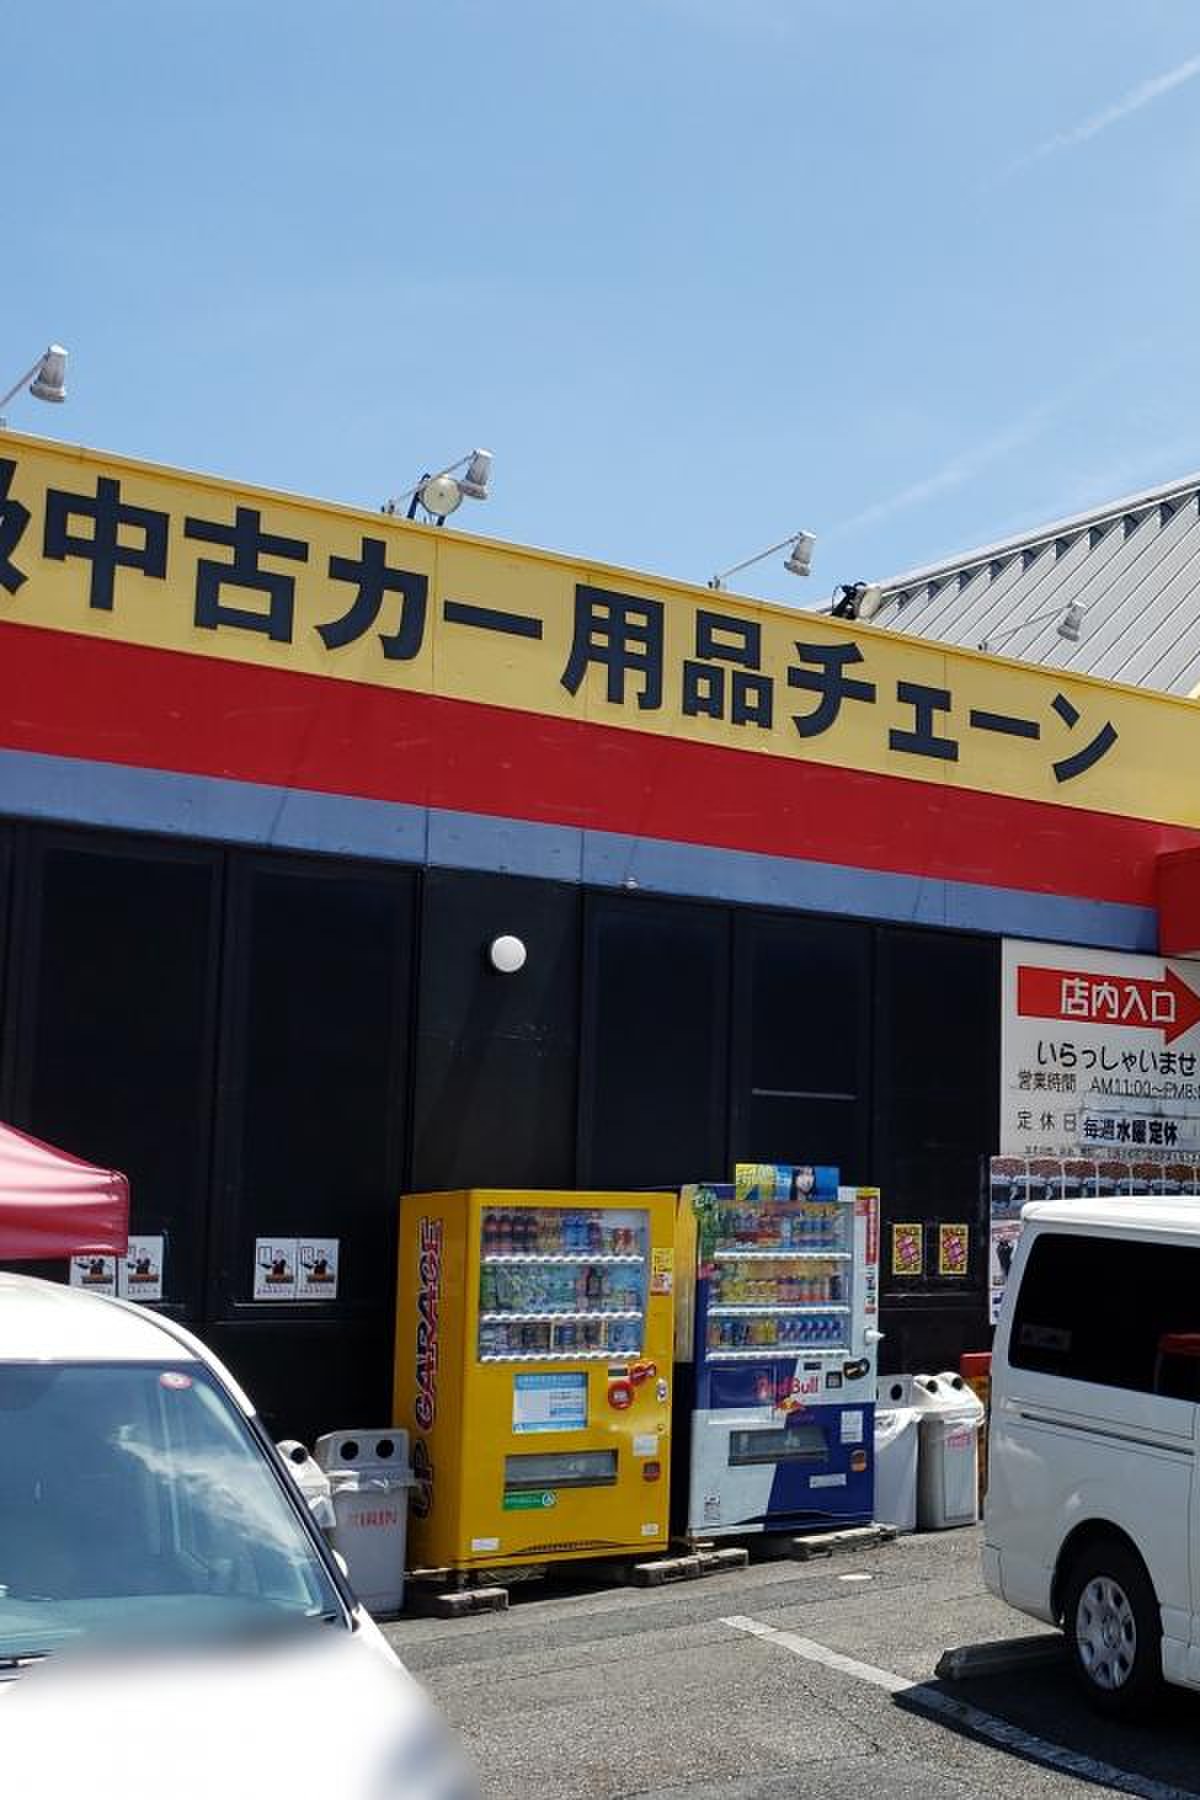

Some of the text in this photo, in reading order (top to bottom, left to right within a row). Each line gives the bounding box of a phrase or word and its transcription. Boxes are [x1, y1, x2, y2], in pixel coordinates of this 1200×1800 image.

[1061, 977, 1175, 1023] 店内入口
[1037, 1040, 1197, 1076] いらっしゃいませ
